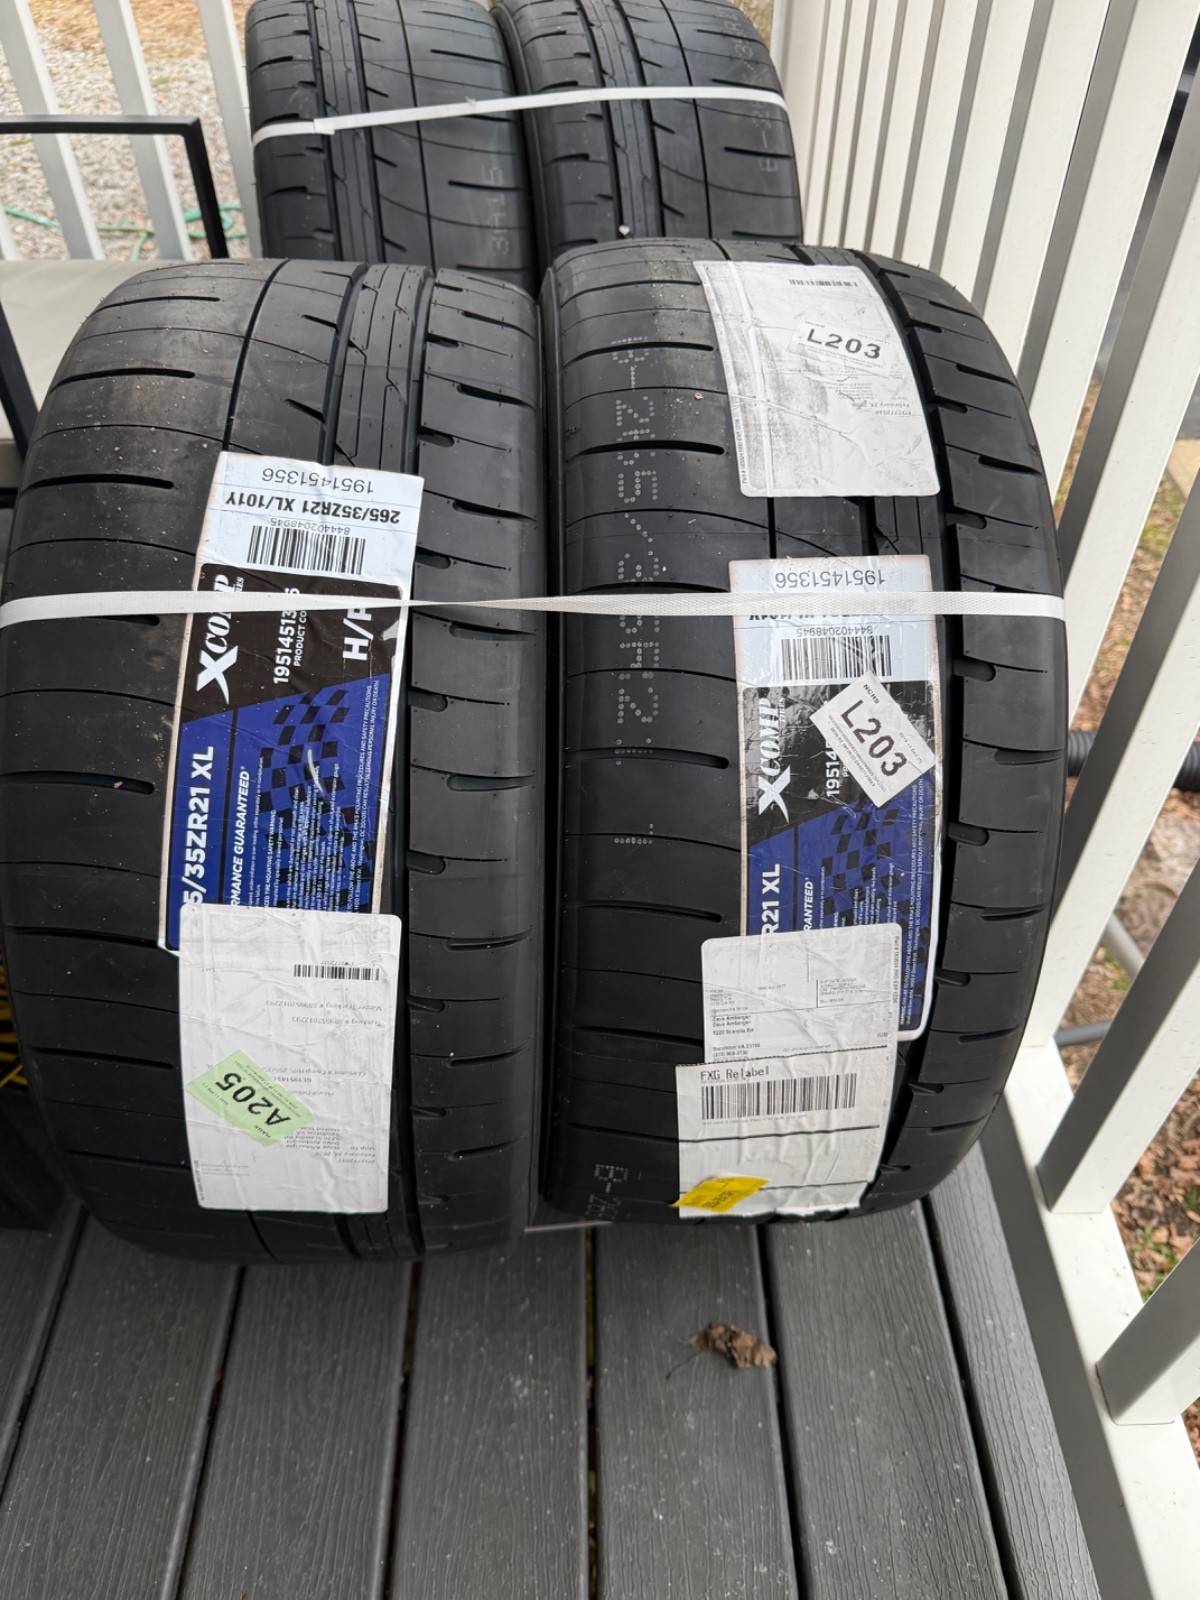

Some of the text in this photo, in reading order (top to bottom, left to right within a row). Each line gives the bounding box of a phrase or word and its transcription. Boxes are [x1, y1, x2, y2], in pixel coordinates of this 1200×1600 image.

[807, 329, 881, 360] L203
[262, 468, 374, 493] 1951451356
[225, 491, 401, 524] 265/35ZR21 XL/101Y
[775, 569, 886, 589] 1951451356
[273, 587, 300, 684] 195145136
[293, 622, 308, 667] PRODUCT
[355, 787, 363, 814] MOUNTING
[363, 685, 372, 720] PRECAUTIONS
[841, 699, 908, 777] L203
[191, 746, 214, 780] XL
[762, 863, 780, 894] XL
[700, 1066, 769, 1082] FXG Relabel
[215, 1071, 292, 1127] A205
